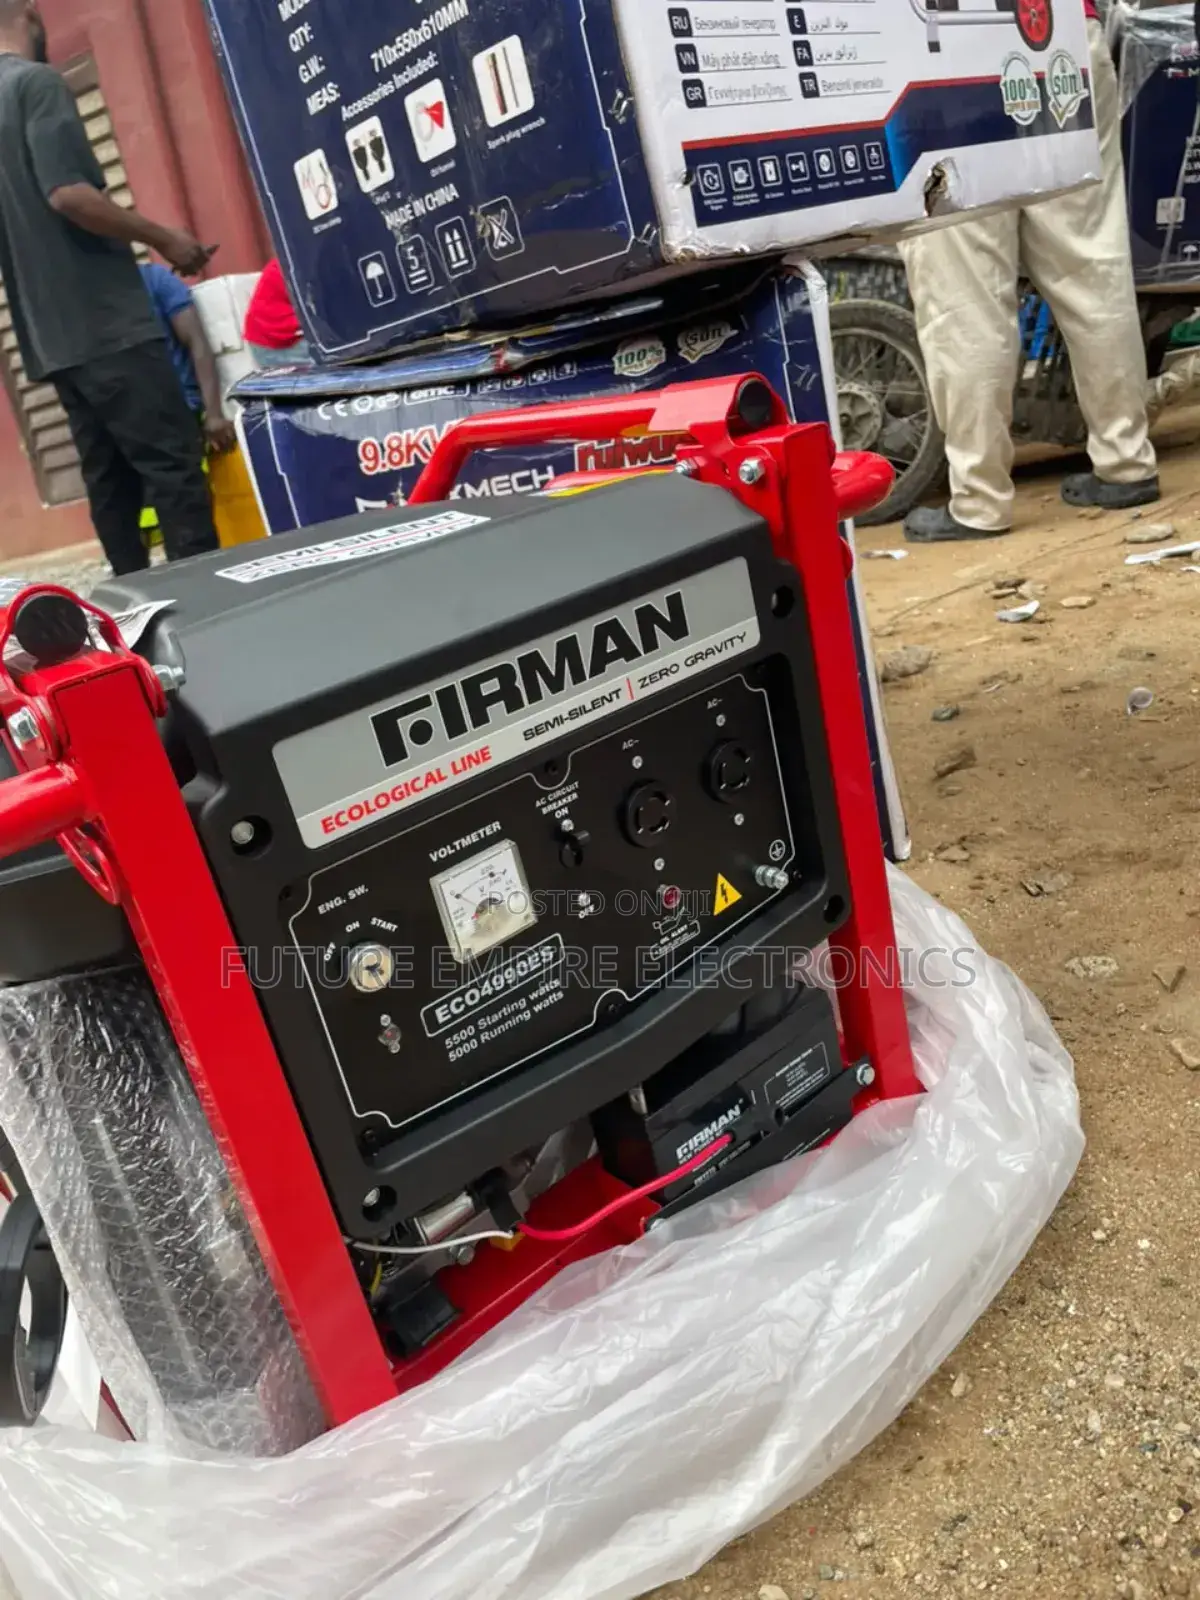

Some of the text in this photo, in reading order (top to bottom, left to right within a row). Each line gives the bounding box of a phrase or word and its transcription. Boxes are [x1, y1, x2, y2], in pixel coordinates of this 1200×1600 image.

[288, 21, 315, 52] QTY:
[671, 16, 689, 30] RU
[680, 51, 696, 66] VN
[797, 47, 811, 60] FA
[306, 81, 341, 116] MEAS:
[341, 51, 440, 121] Accessories Included:
[685, 87, 703, 101] GR
[802, 79, 817, 91] TR
[1001, 78, 1039, 101] 100%
[411, 198, 427, 219] IN
[423, 182, 461, 211] CHINA
[406, 245, 420, 271] 5
[616, 347, 663, 370] 100%
[368, 588, 692, 769] FIRMAN
[522, 630, 749, 742] SEMI-SILENT ZERO GRAVITY
[321, 744, 494, 836] ECOLOGICAL LINE
[535, 780, 580, 808] AC CIRCUIT
[541, 791, 579, 816] BREAKER
[554, 806, 569, 819] ON
[428, 820, 503, 863] VOLTMETER
[317, 885, 370, 915] ENG. SW.
[577, 903, 596, 920] OFF
[345, 919, 361, 934] ON
[369, 916, 399, 933] START
[323, 941, 337, 963] OFF
[434, 944, 556, 1025] ECO4990ES
[444, 976, 562, 1050] 5500 Starting watts
[447, 989, 565, 1062] 5000 Running watts
[676, 1103, 742, 1159] FIRMAN
